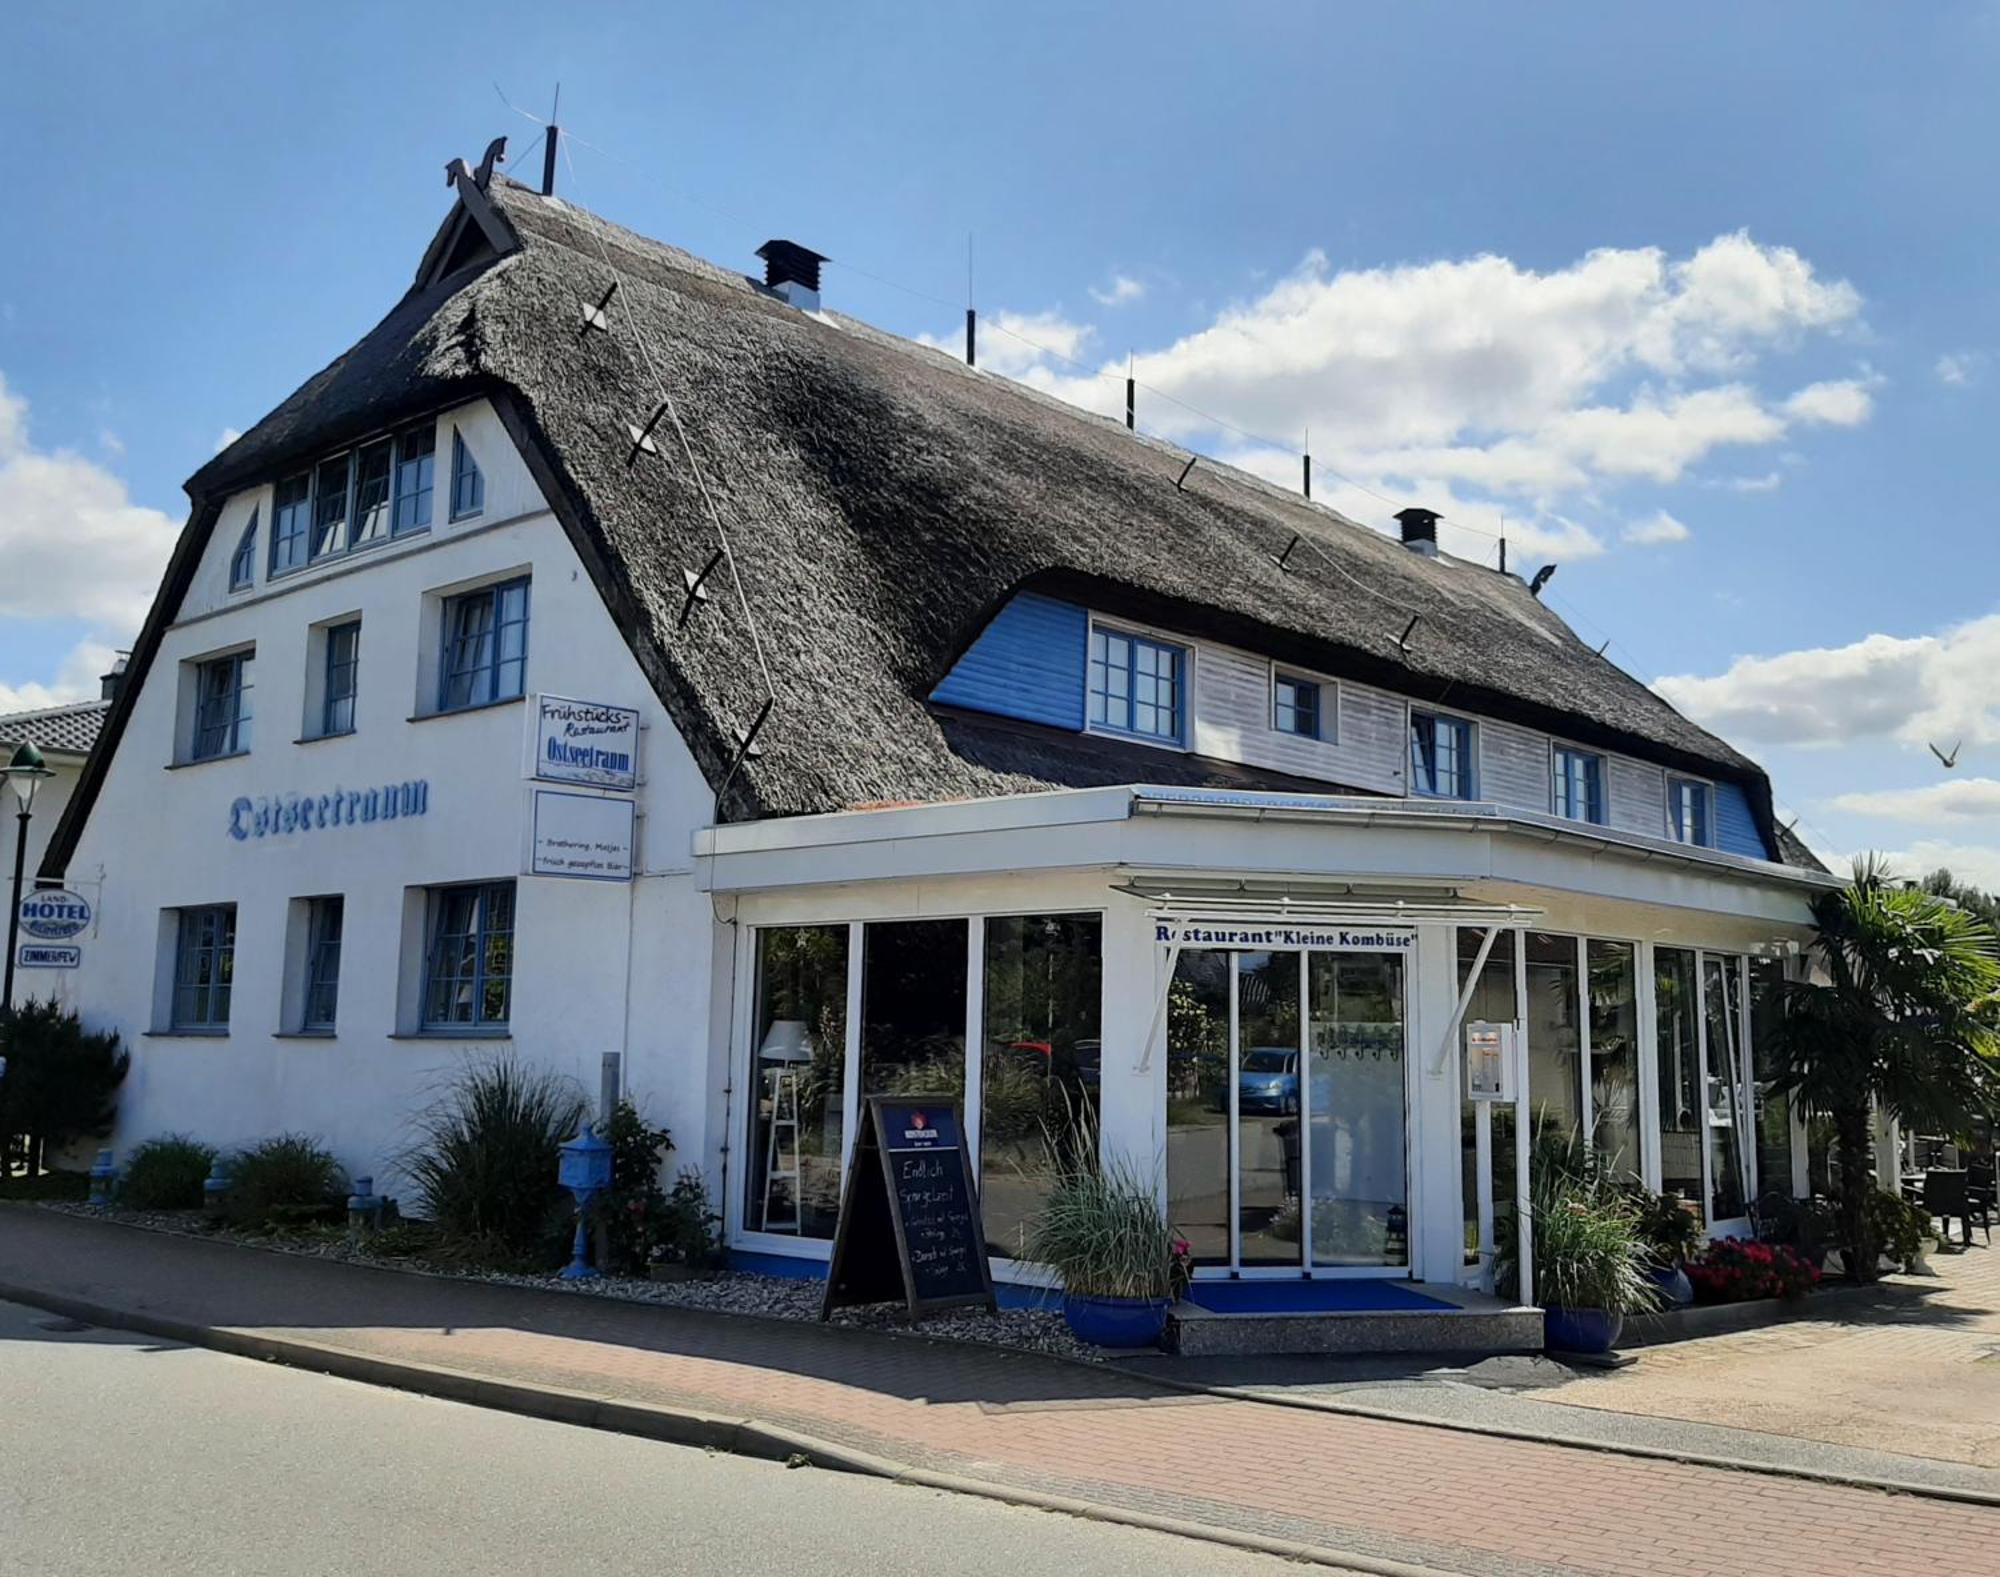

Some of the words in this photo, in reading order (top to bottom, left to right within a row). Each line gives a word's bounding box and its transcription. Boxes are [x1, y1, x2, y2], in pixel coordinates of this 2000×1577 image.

[541, 704, 630, 724] Frühstücks-
[564, 722, 630, 738] Restaurant
[547, 736, 629, 771] Ostseetraum
[227, 779, 429, 841] Ostseetraum
[22, 903, 89, 920] HOTEL
[1156, 925, 1273, 944] Rstaurant
